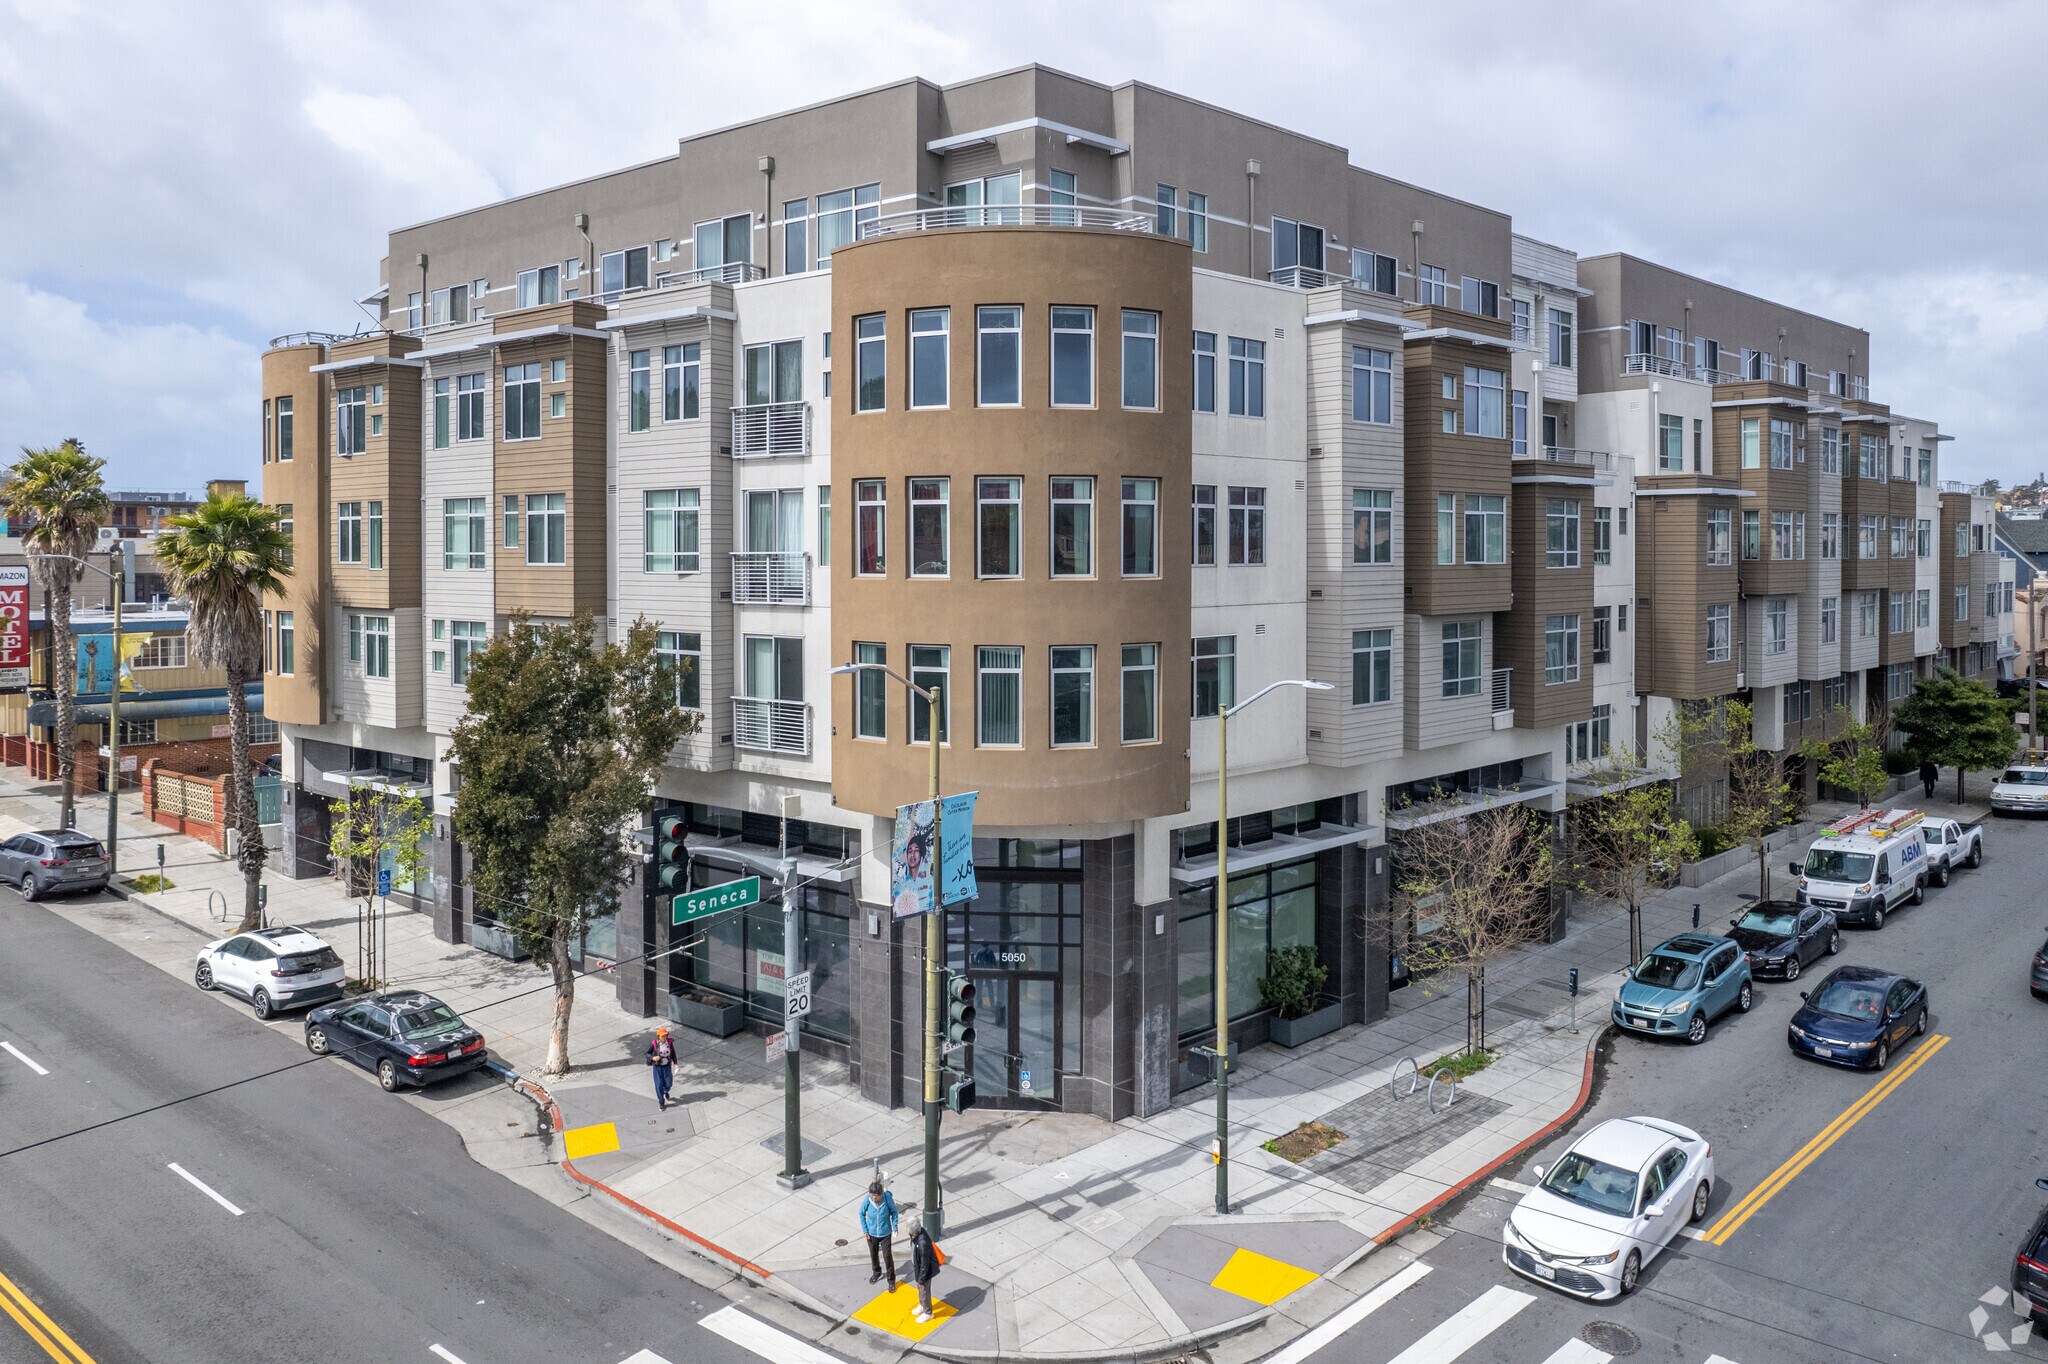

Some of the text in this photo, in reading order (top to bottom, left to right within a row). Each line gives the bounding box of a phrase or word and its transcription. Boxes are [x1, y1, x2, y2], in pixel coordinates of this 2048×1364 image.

[1901, 841, 1922, 866] ABM
[687, 889, 747, 914] Seneca
[1001, 952, 1026, 962] 5050
[787, 976, 809, 989] SPEED
[790, 985, 807, 997] LIMIT
[789, 994, 809, 1015] 20
